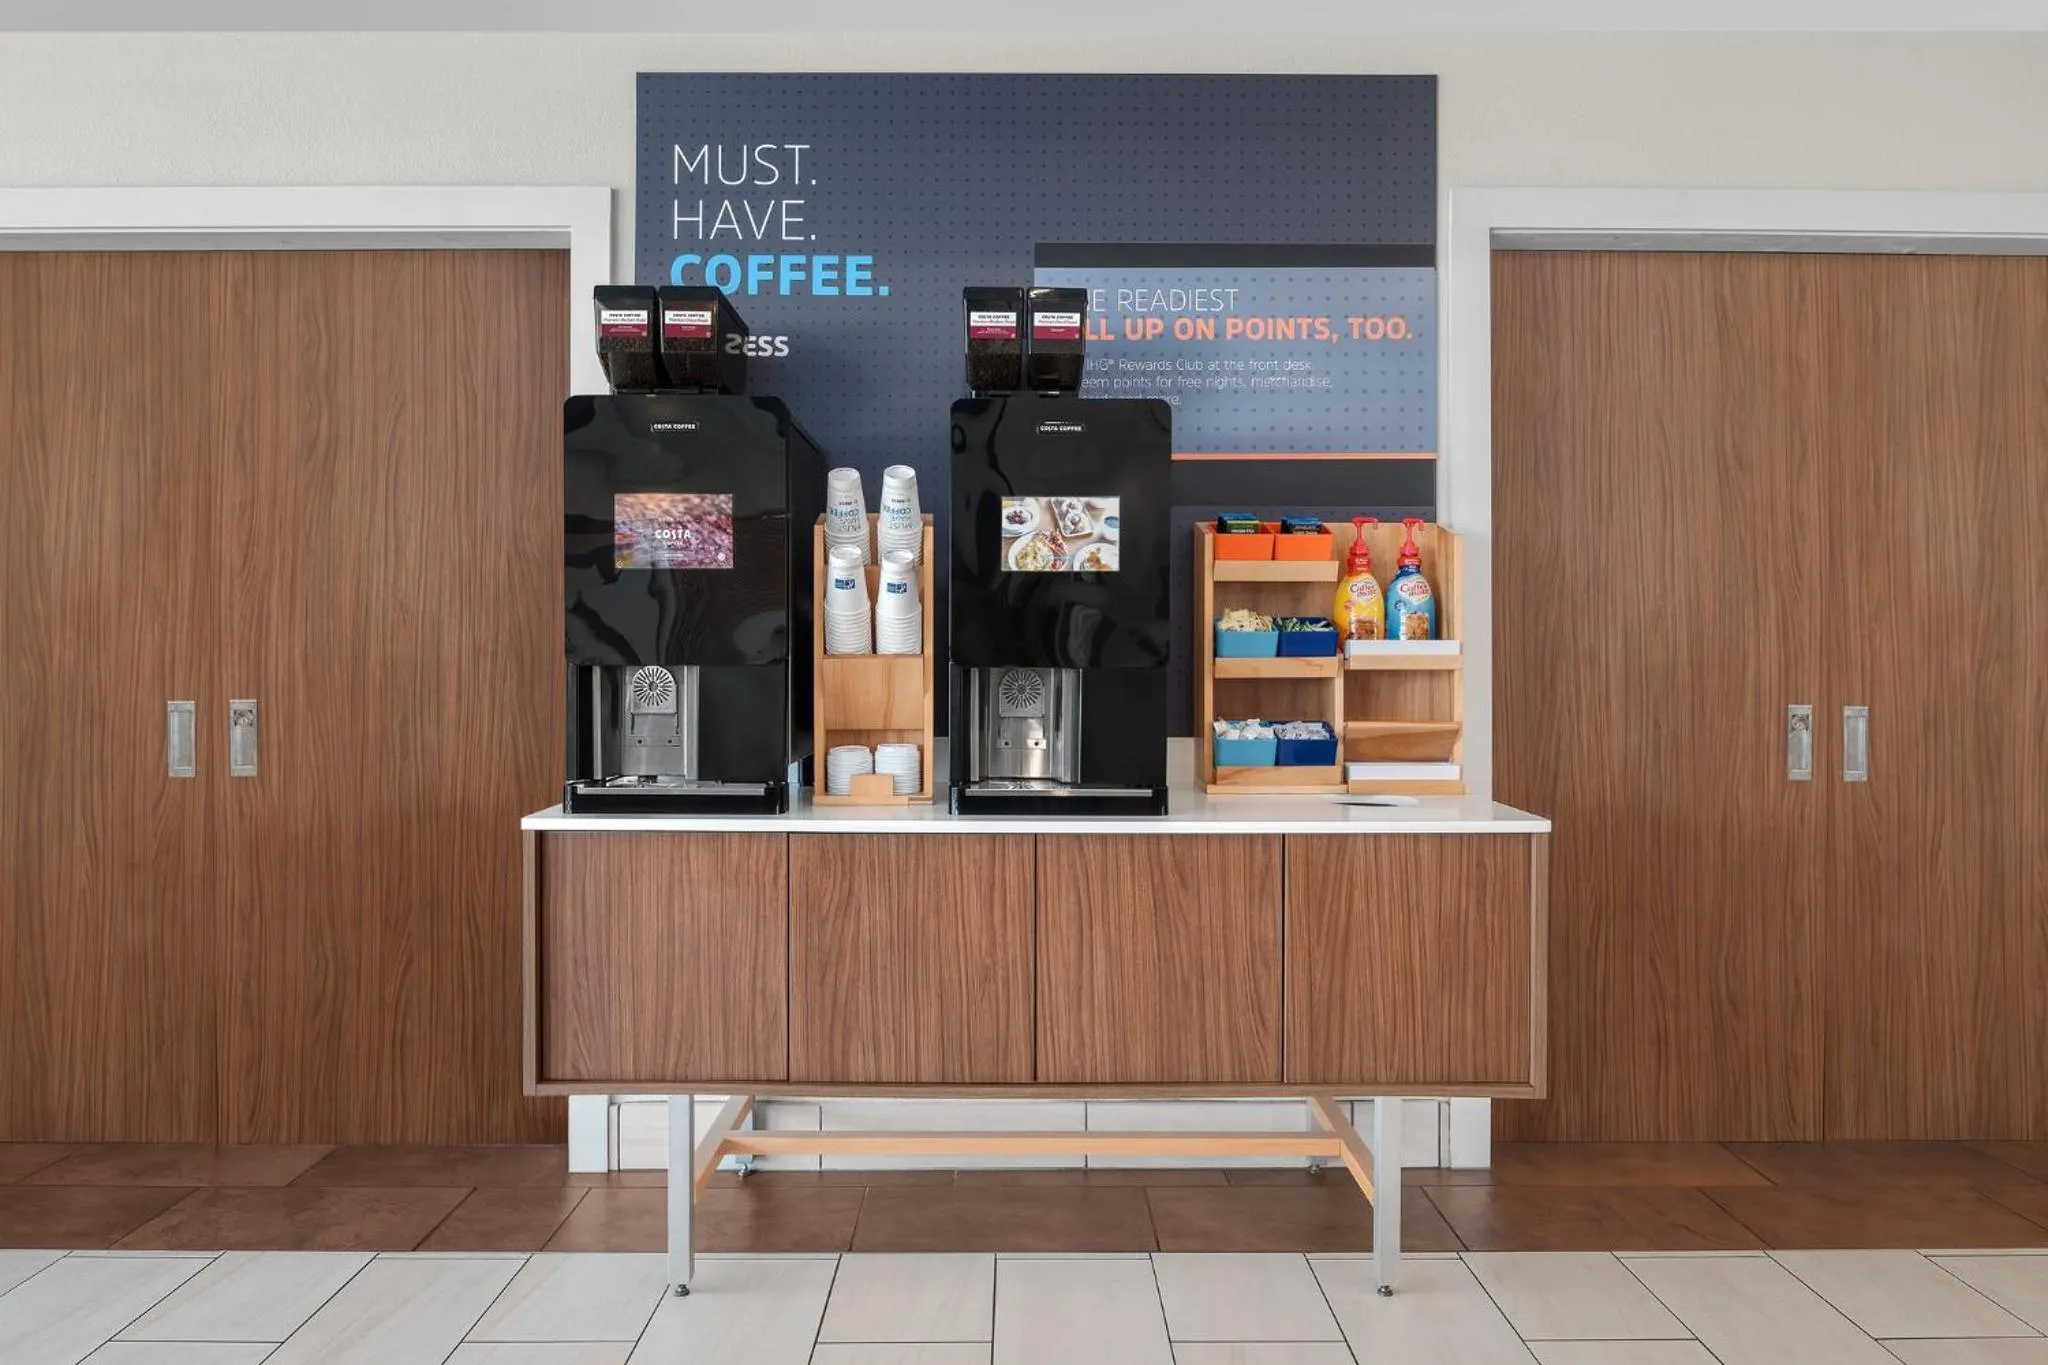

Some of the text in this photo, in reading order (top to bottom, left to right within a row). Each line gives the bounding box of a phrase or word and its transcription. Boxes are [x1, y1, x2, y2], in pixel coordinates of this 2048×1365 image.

[673, 144, 817, 185] MUST.
[673, 199, 817, 241] HAVE.
[670, 253, 891, 296] COFFEE.
[1117, 288, 1239, 312] READIEST
[1125, 316, 1165, 341] UP
[1174, 316, 1216, 341] ON
[1225, 316, 1339, 344] POINTS,
[1347, 316, 1414, 341] TOO.
[1119, 359, 1171, 371] Rewards
[1176, 359, 1203, 371] Club
[1208, 360, 1220, 371] at
[1224, 359, 1244, 371] the
[1249, 358, 1279, 371] front
[1114, 376, 1151, 390] points
[1156, 376, 1173, 388] for
[1177, 376, 1202, 388] free
[654, 529, 691, 540] COSTA
